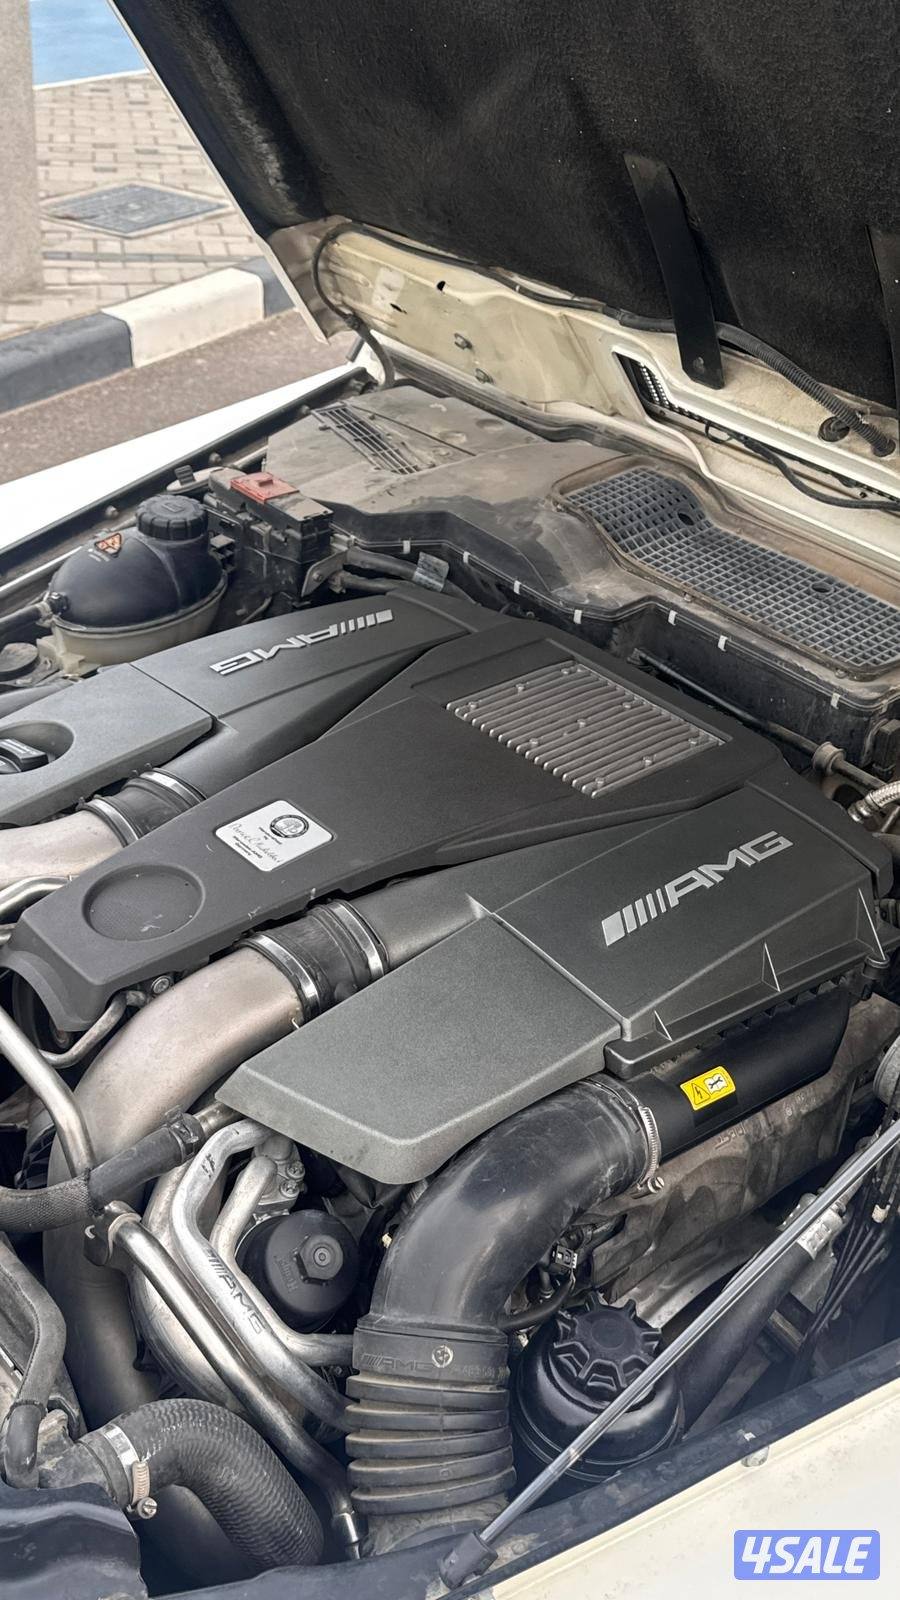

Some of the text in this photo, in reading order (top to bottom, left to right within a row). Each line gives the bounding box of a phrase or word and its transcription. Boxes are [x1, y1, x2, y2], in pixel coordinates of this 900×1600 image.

[209, 624, 338, 676] AMG
[664, 830, 794, 909] AMG
[219, 1275, 267, 1335] AMG
